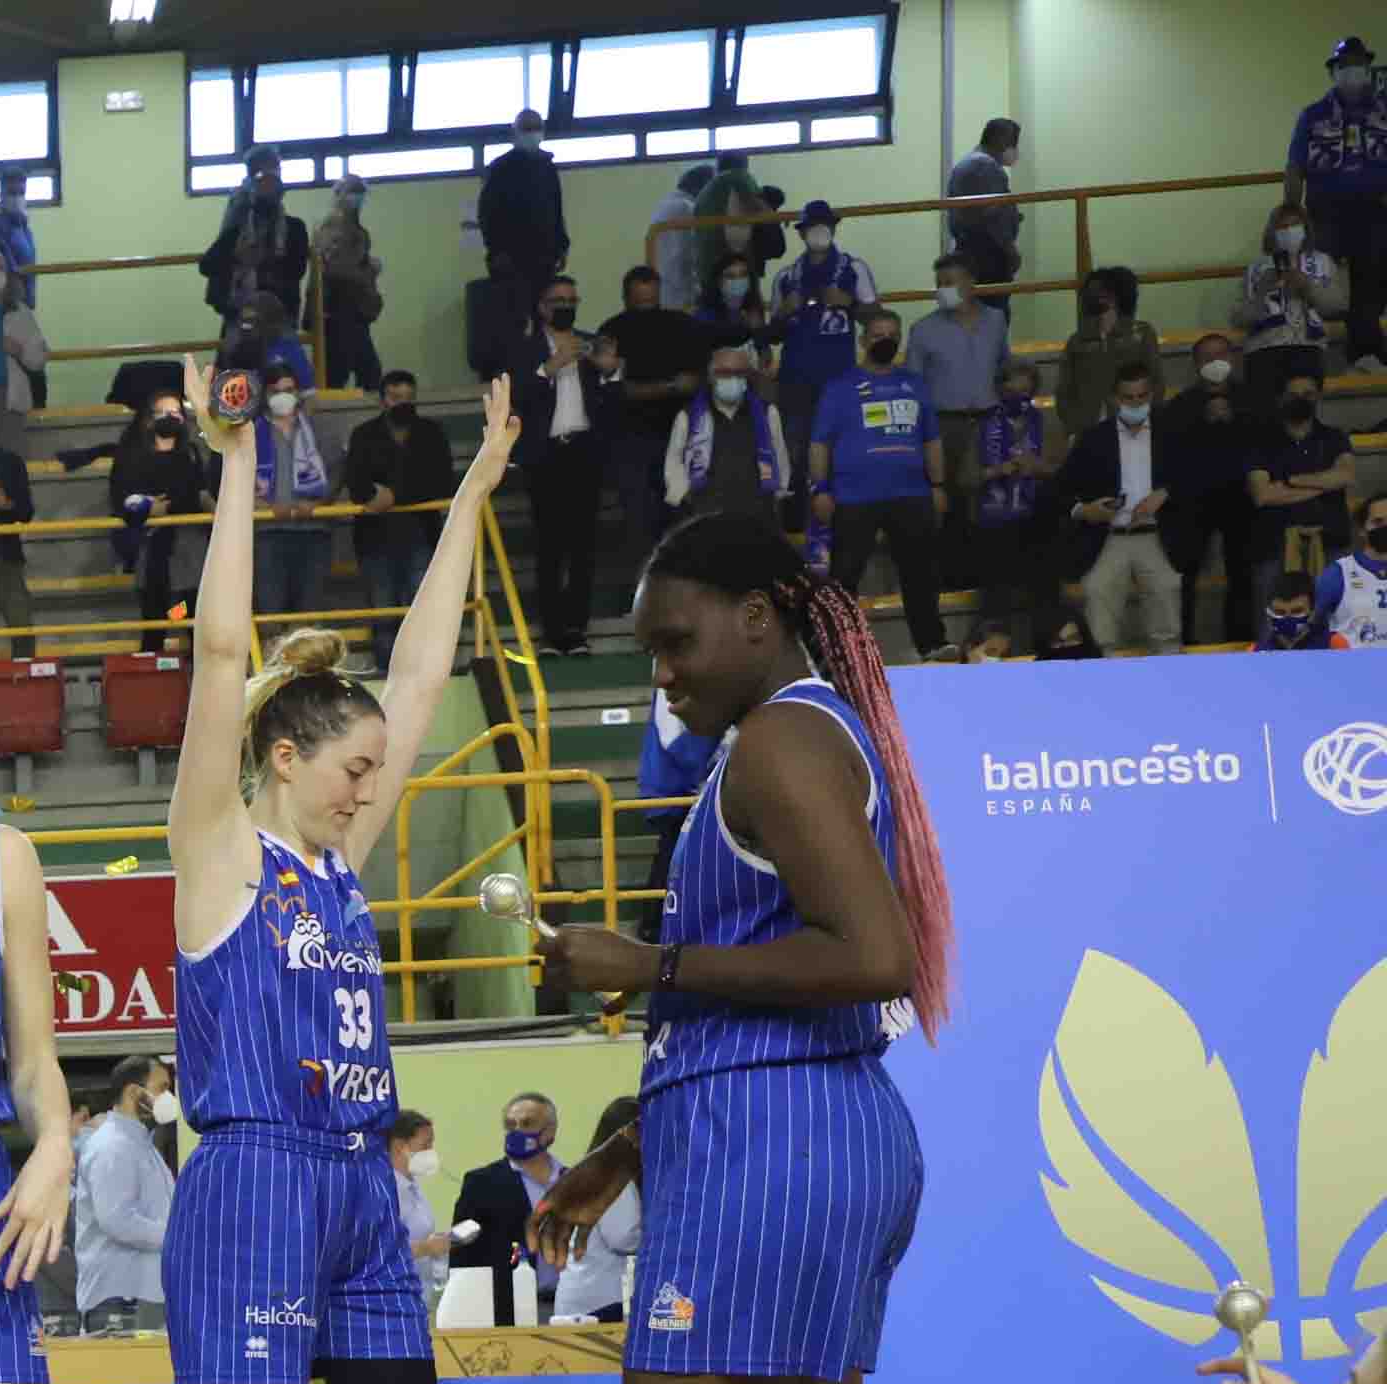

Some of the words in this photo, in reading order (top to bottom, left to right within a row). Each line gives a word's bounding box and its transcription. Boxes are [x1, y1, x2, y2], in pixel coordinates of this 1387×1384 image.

[986, 793, 1093, 816] ESPAÑA
[334, 987, 374, 1050] 33
[322, 1058, 392, 1104] YRSA
